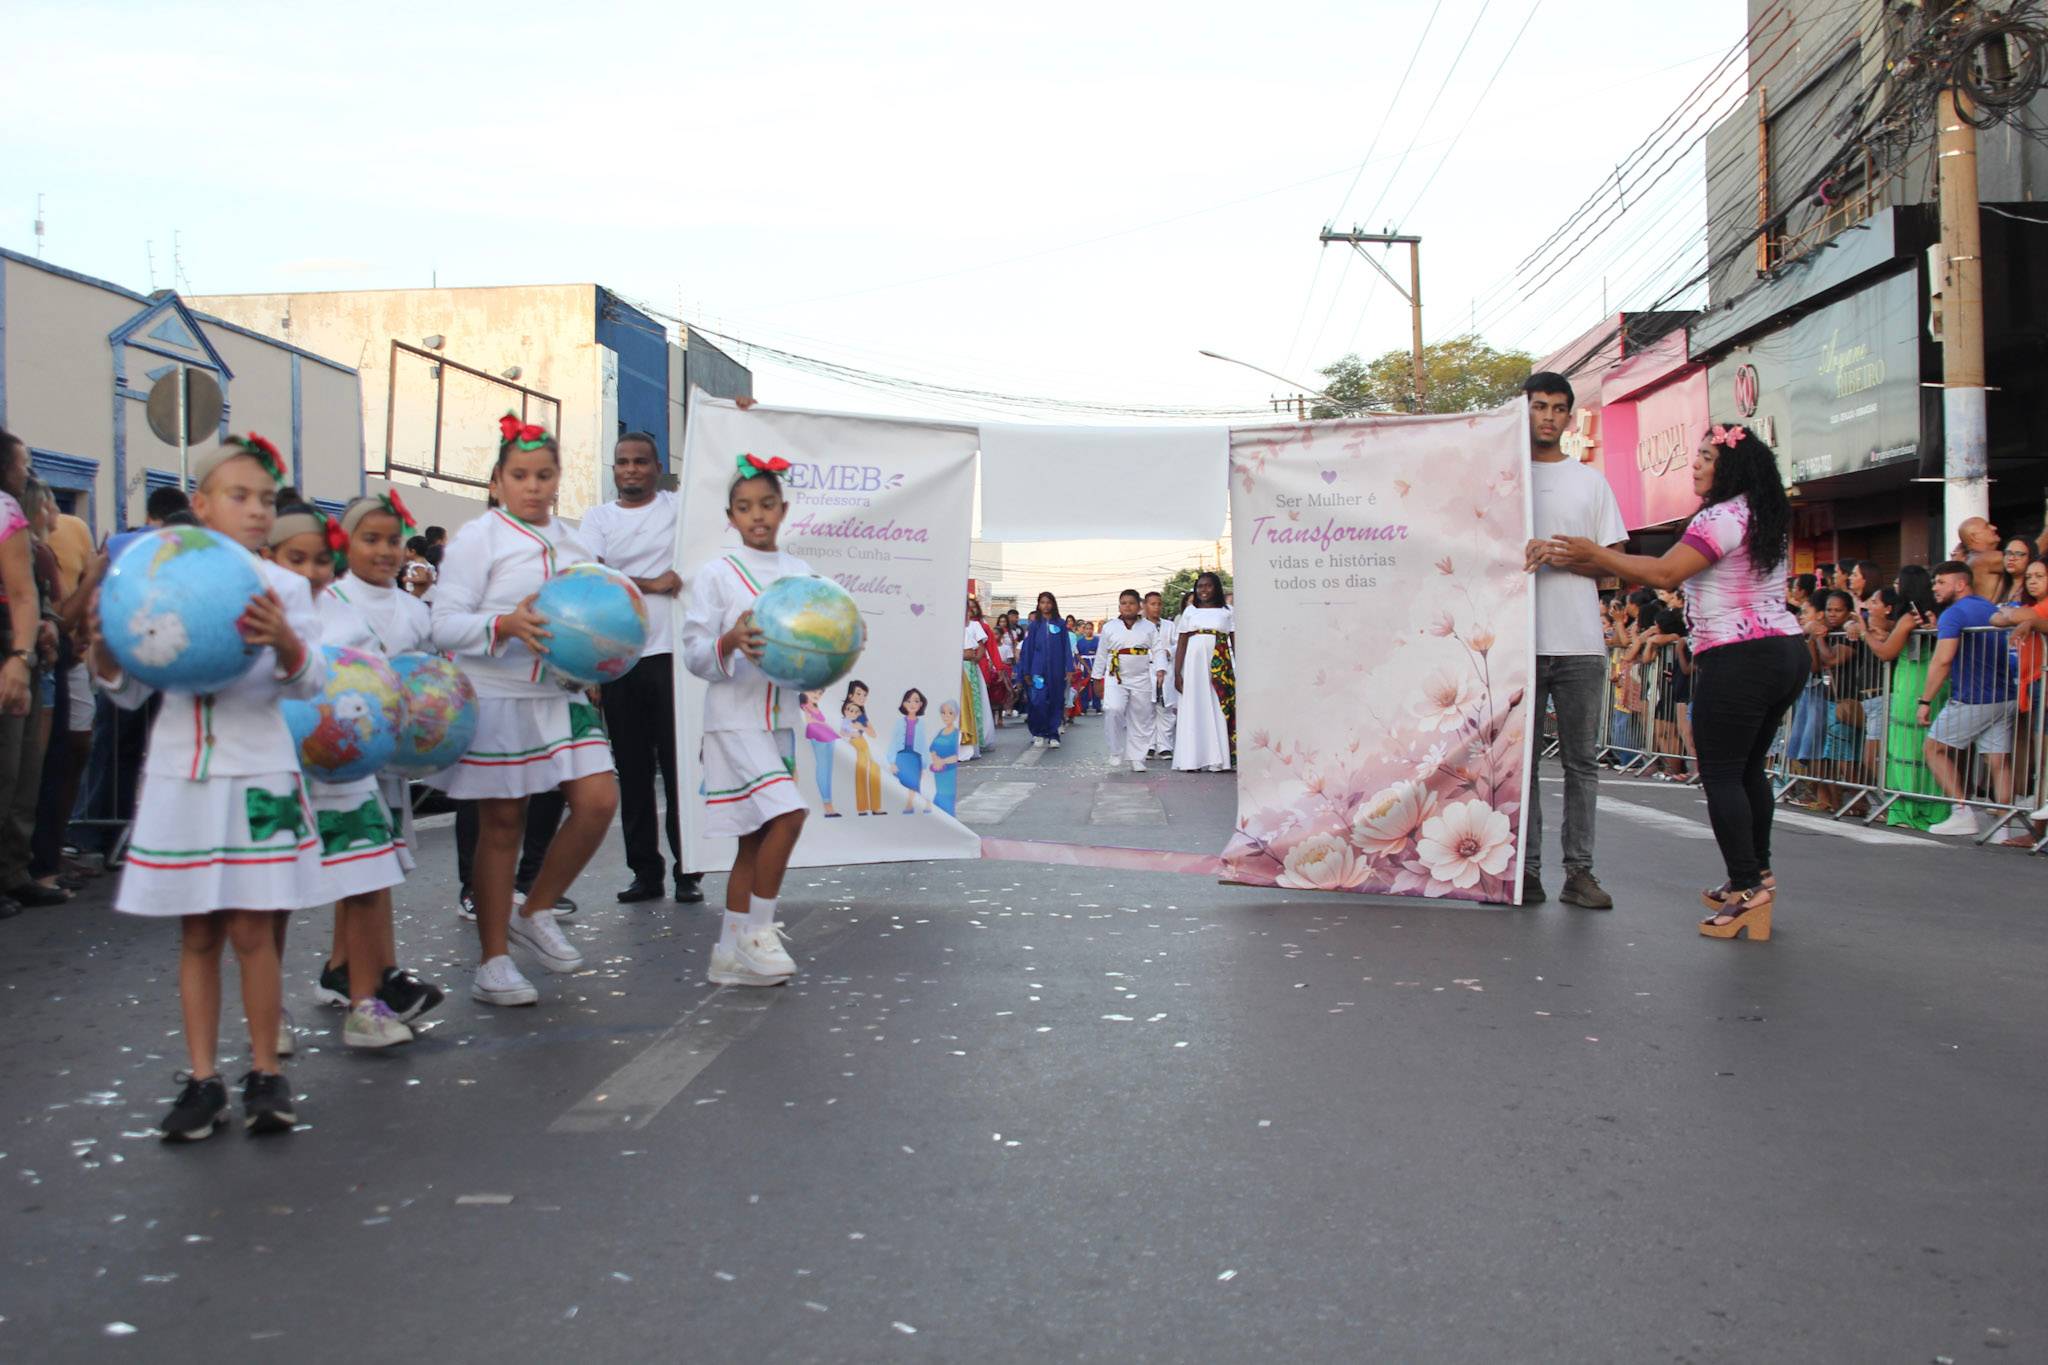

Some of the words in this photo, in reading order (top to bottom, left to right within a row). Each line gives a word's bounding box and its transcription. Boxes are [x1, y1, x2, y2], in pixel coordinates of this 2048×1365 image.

[787, 462, 882, 492] EMEB
[796, 491, 871, 508] Professora
[1276, 494, 1302, 508] Ser
[1307, 492, 1362, 507] Mulher
[1368, 492, 1377, 506] é
[785, 513, 930, 544] Auxiliadora
[1251, 515, 1409, 551] Transformar
[785, 543, 842, 559] Campos
[847, 546, 891, 561] Cunha
[1269, 555, 1309, 569] vidas
[1315, 558, 1324, 568] e
[1329, 553, 1397, 568] histórias
[1274, 575, 1317, 590] todos
[1322, 577, 1340, 589] os
[1345, 574, 1377, 588] dias
